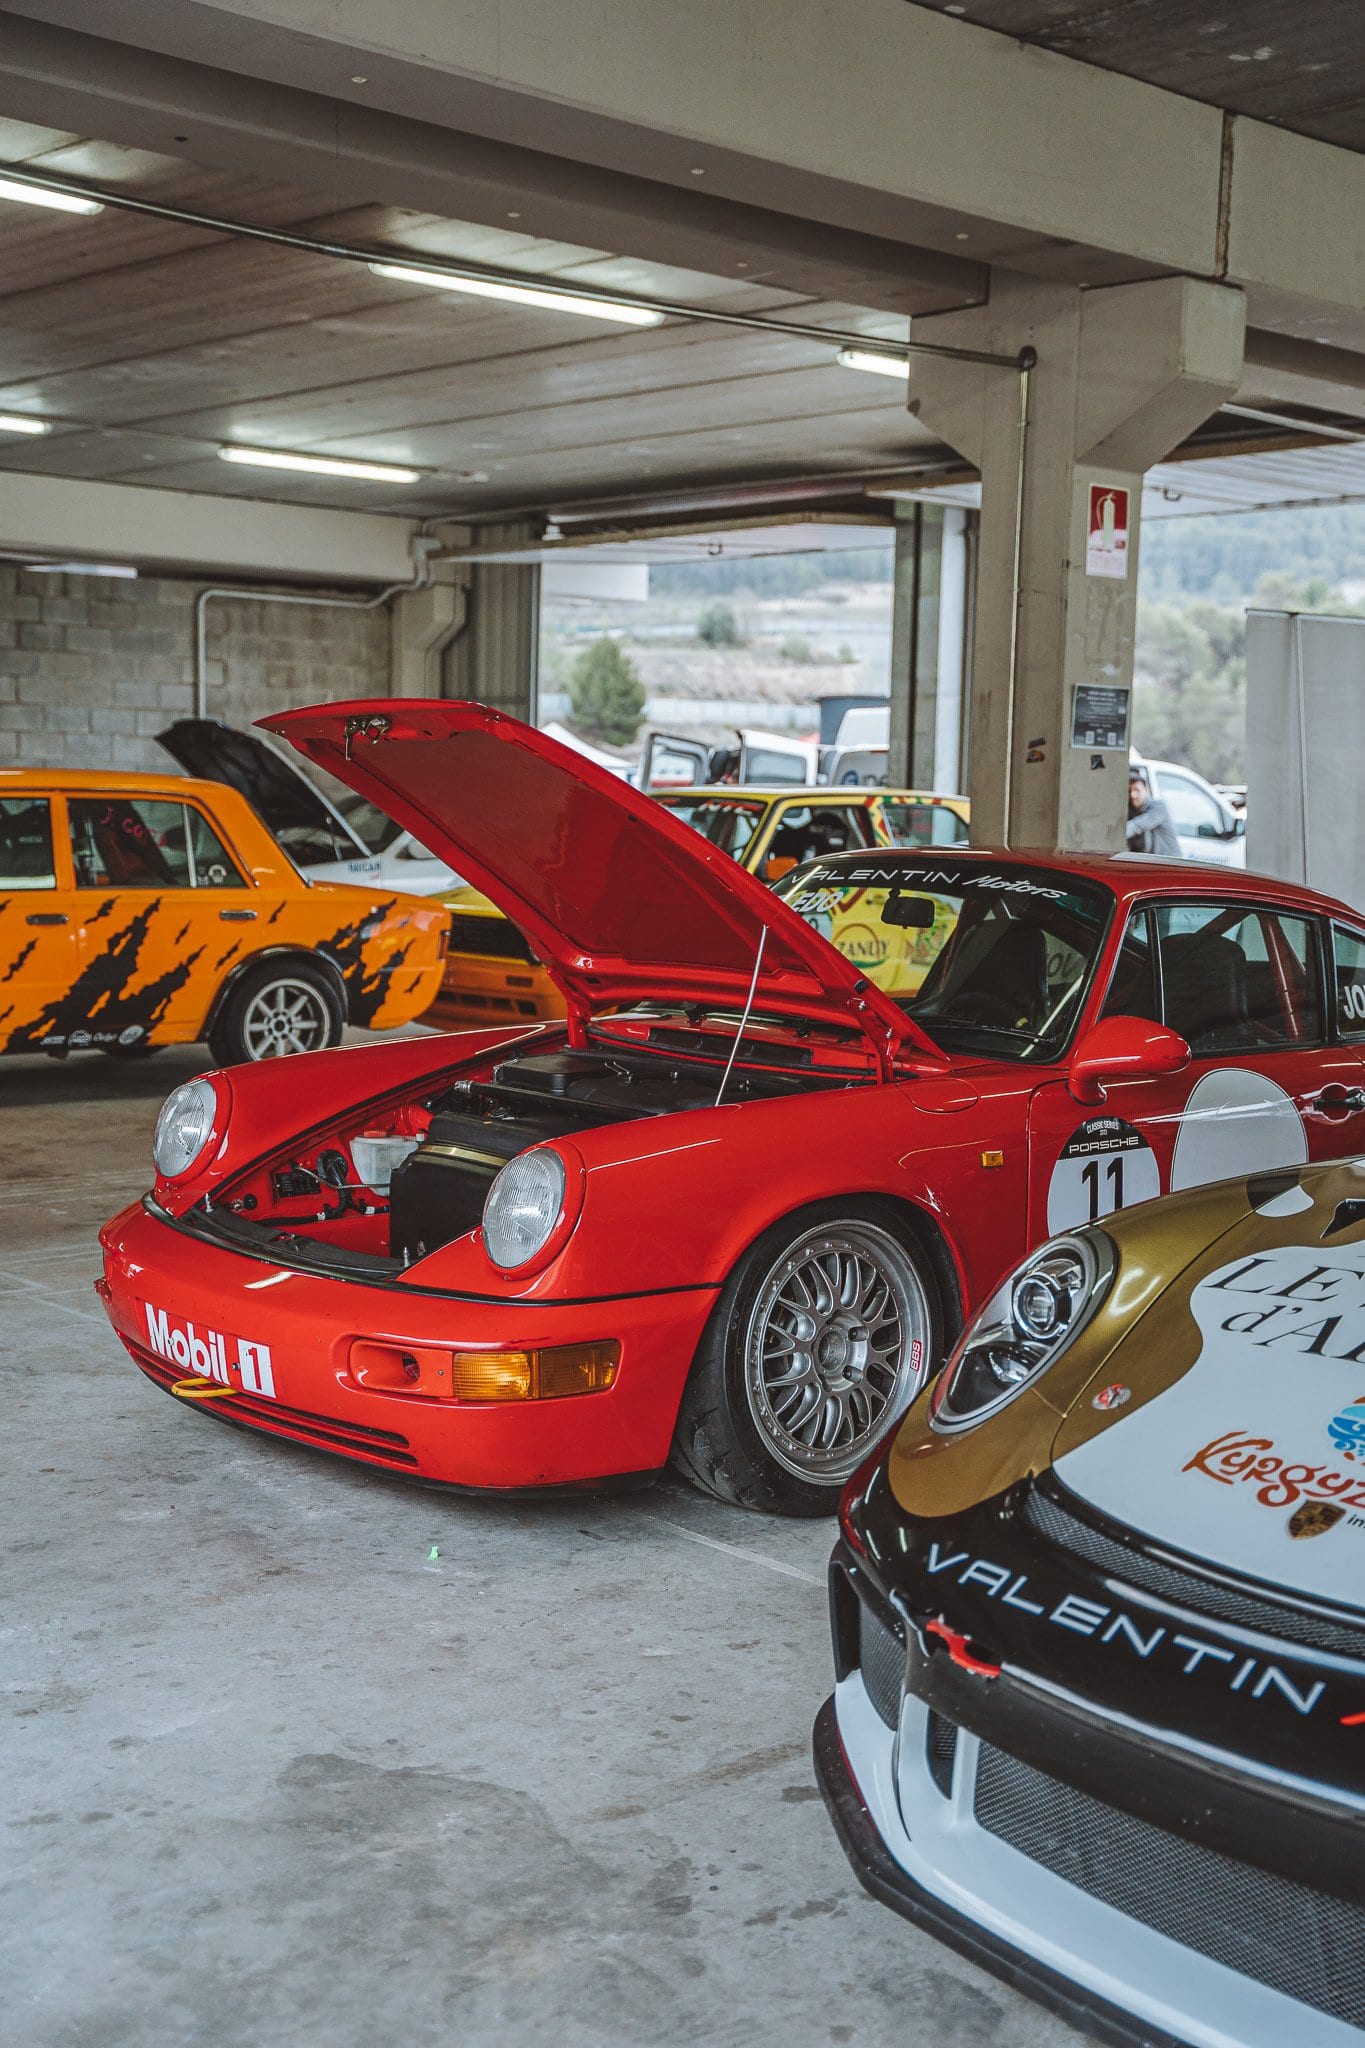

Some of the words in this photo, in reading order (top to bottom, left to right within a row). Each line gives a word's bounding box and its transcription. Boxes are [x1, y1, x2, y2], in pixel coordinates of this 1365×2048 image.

[791, 869, 960, 884] VALENTIN
[962, 875, 1067, 899] Motors
[778, 891, 844, 912] EDO
[1343, 984, 1365, 1020] JO
[1086, 1120, 1104, 1135] CLASSIC
[1103, 1120, 1120, 1131] SERIES
[1068, 1136, 1139, 1154] PORSCHE
[1082, 1157, 1123, 1221] 11
[1201, 1257, 1365, 1308] LE
[144, 1301, 231, 1386] Mobil
[910, 1341, 921, 1371] BBS
[1346, 1513, 1365, 1529] in
[927, 1542, 1327, 1716] VALENTIN
